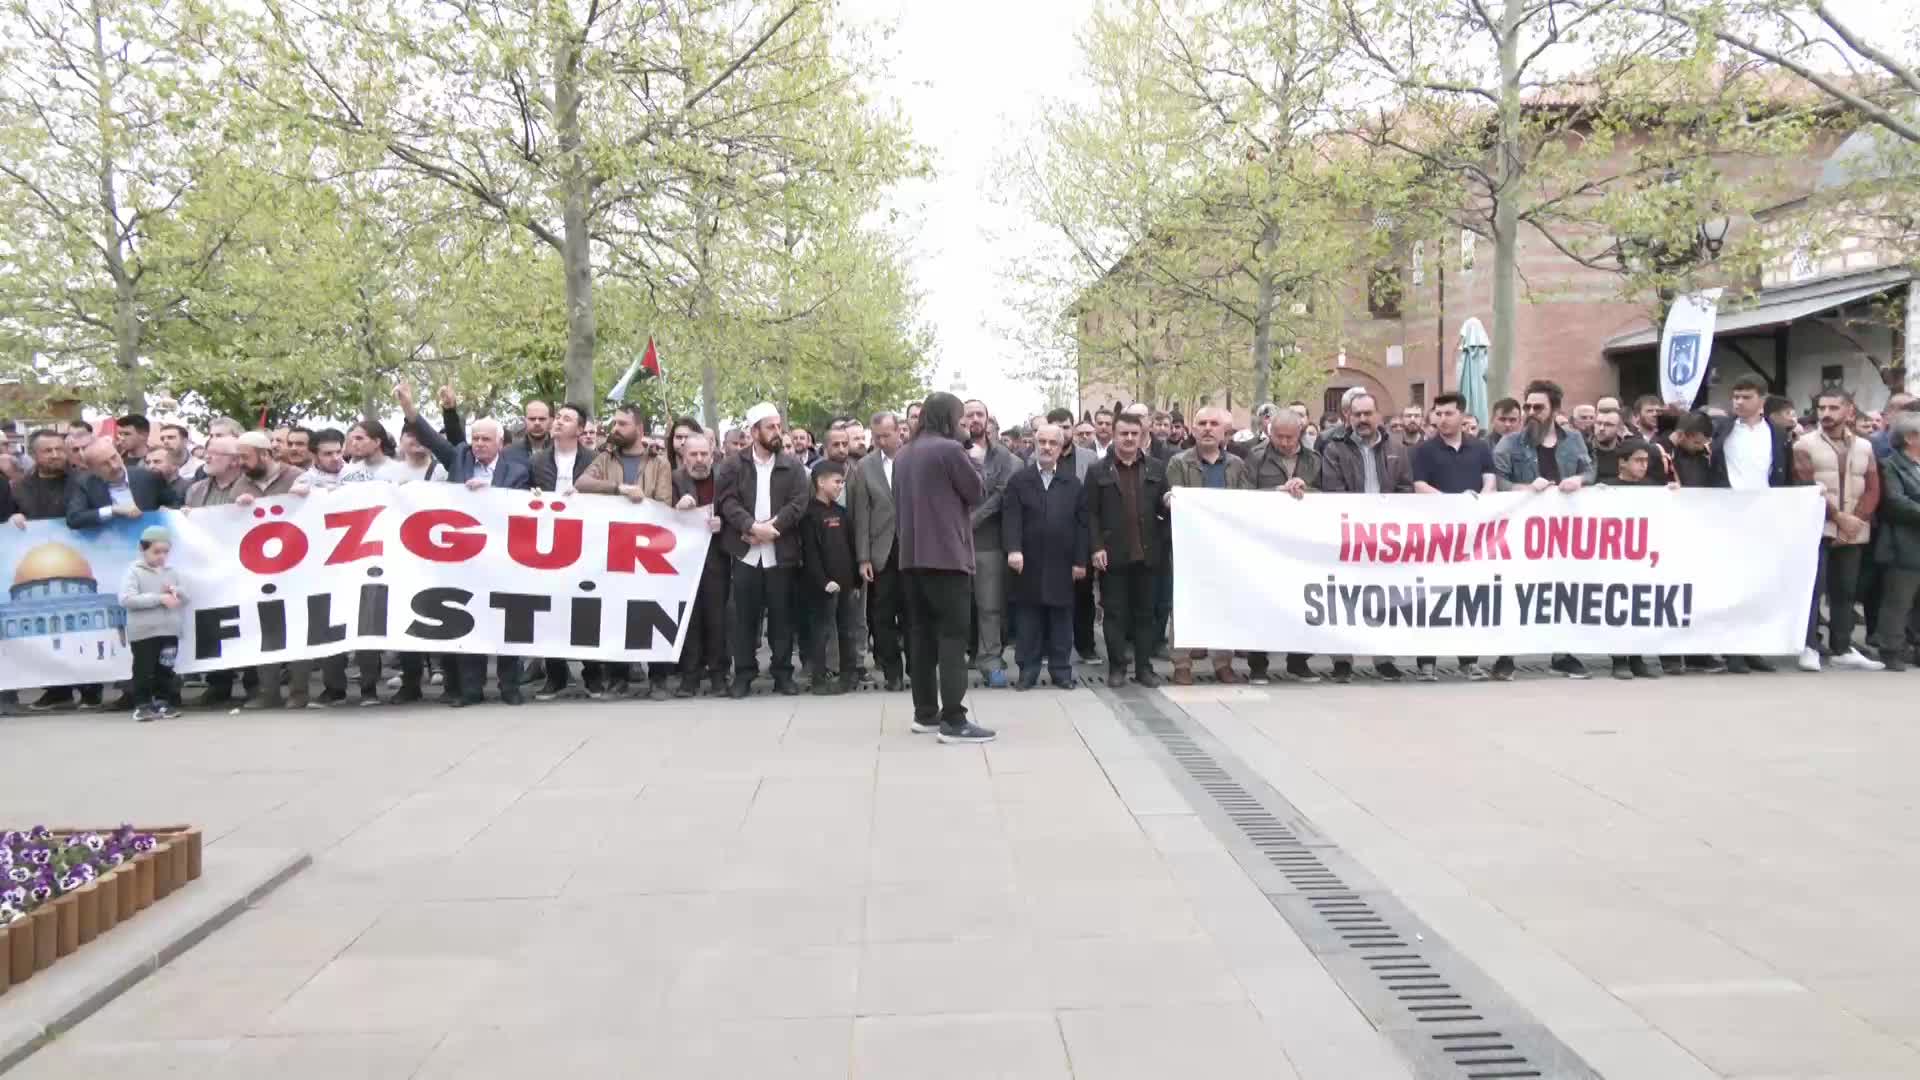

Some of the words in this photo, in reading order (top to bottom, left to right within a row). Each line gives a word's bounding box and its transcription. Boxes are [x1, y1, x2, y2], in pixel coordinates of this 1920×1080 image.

[238, 500, 681, 576] ÖZGÜR
[1338, 513, 1513, 565] İNSANLIK
[1523, 515, 1662, 569] ONURU,
[193, 566, 688, 661] FİLİSTİN
[1303, 573, 1503, 629] SİYONİZMİ
[1514, 582, 1694, 629] YENECEK!
